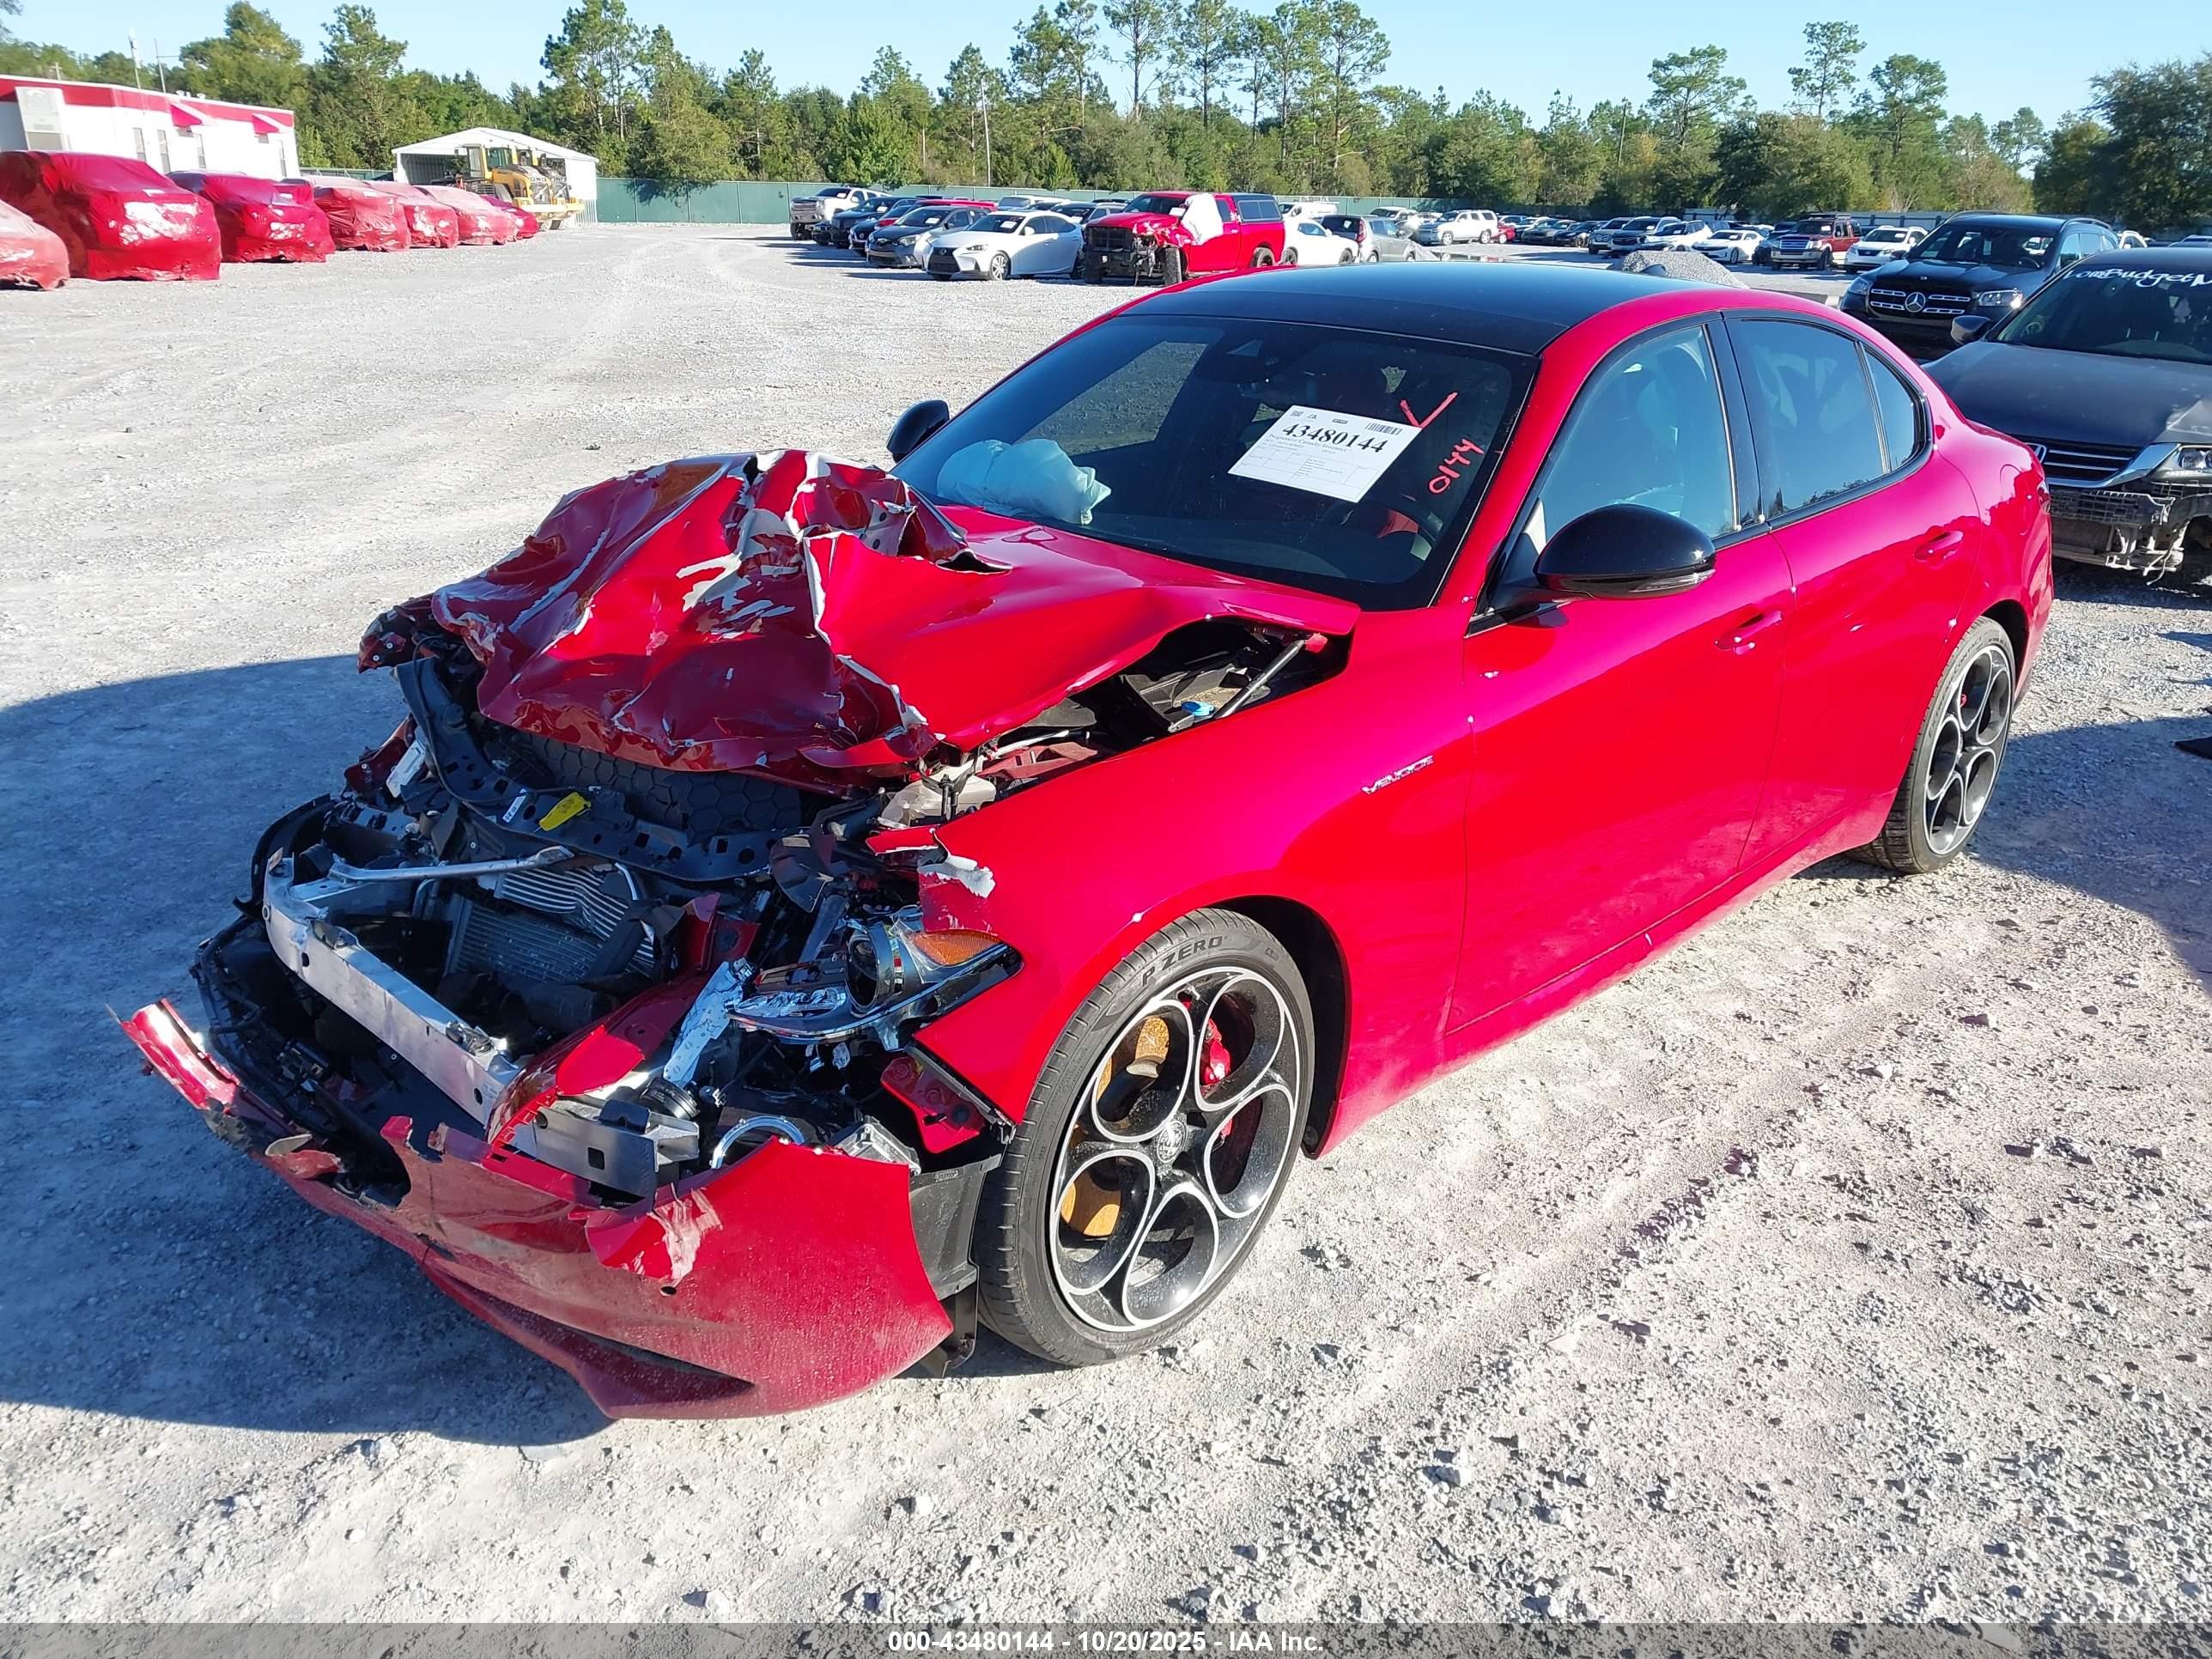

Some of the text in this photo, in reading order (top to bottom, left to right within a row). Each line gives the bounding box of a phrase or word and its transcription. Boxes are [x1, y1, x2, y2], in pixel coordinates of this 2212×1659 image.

[1283, 423, 1389, 453] 43480144
[1429, 438, 1485, 494] 0144
[1362, 755, 1435, 794] VELOCE
[1141, 935, 1224, 987] P ZERO
